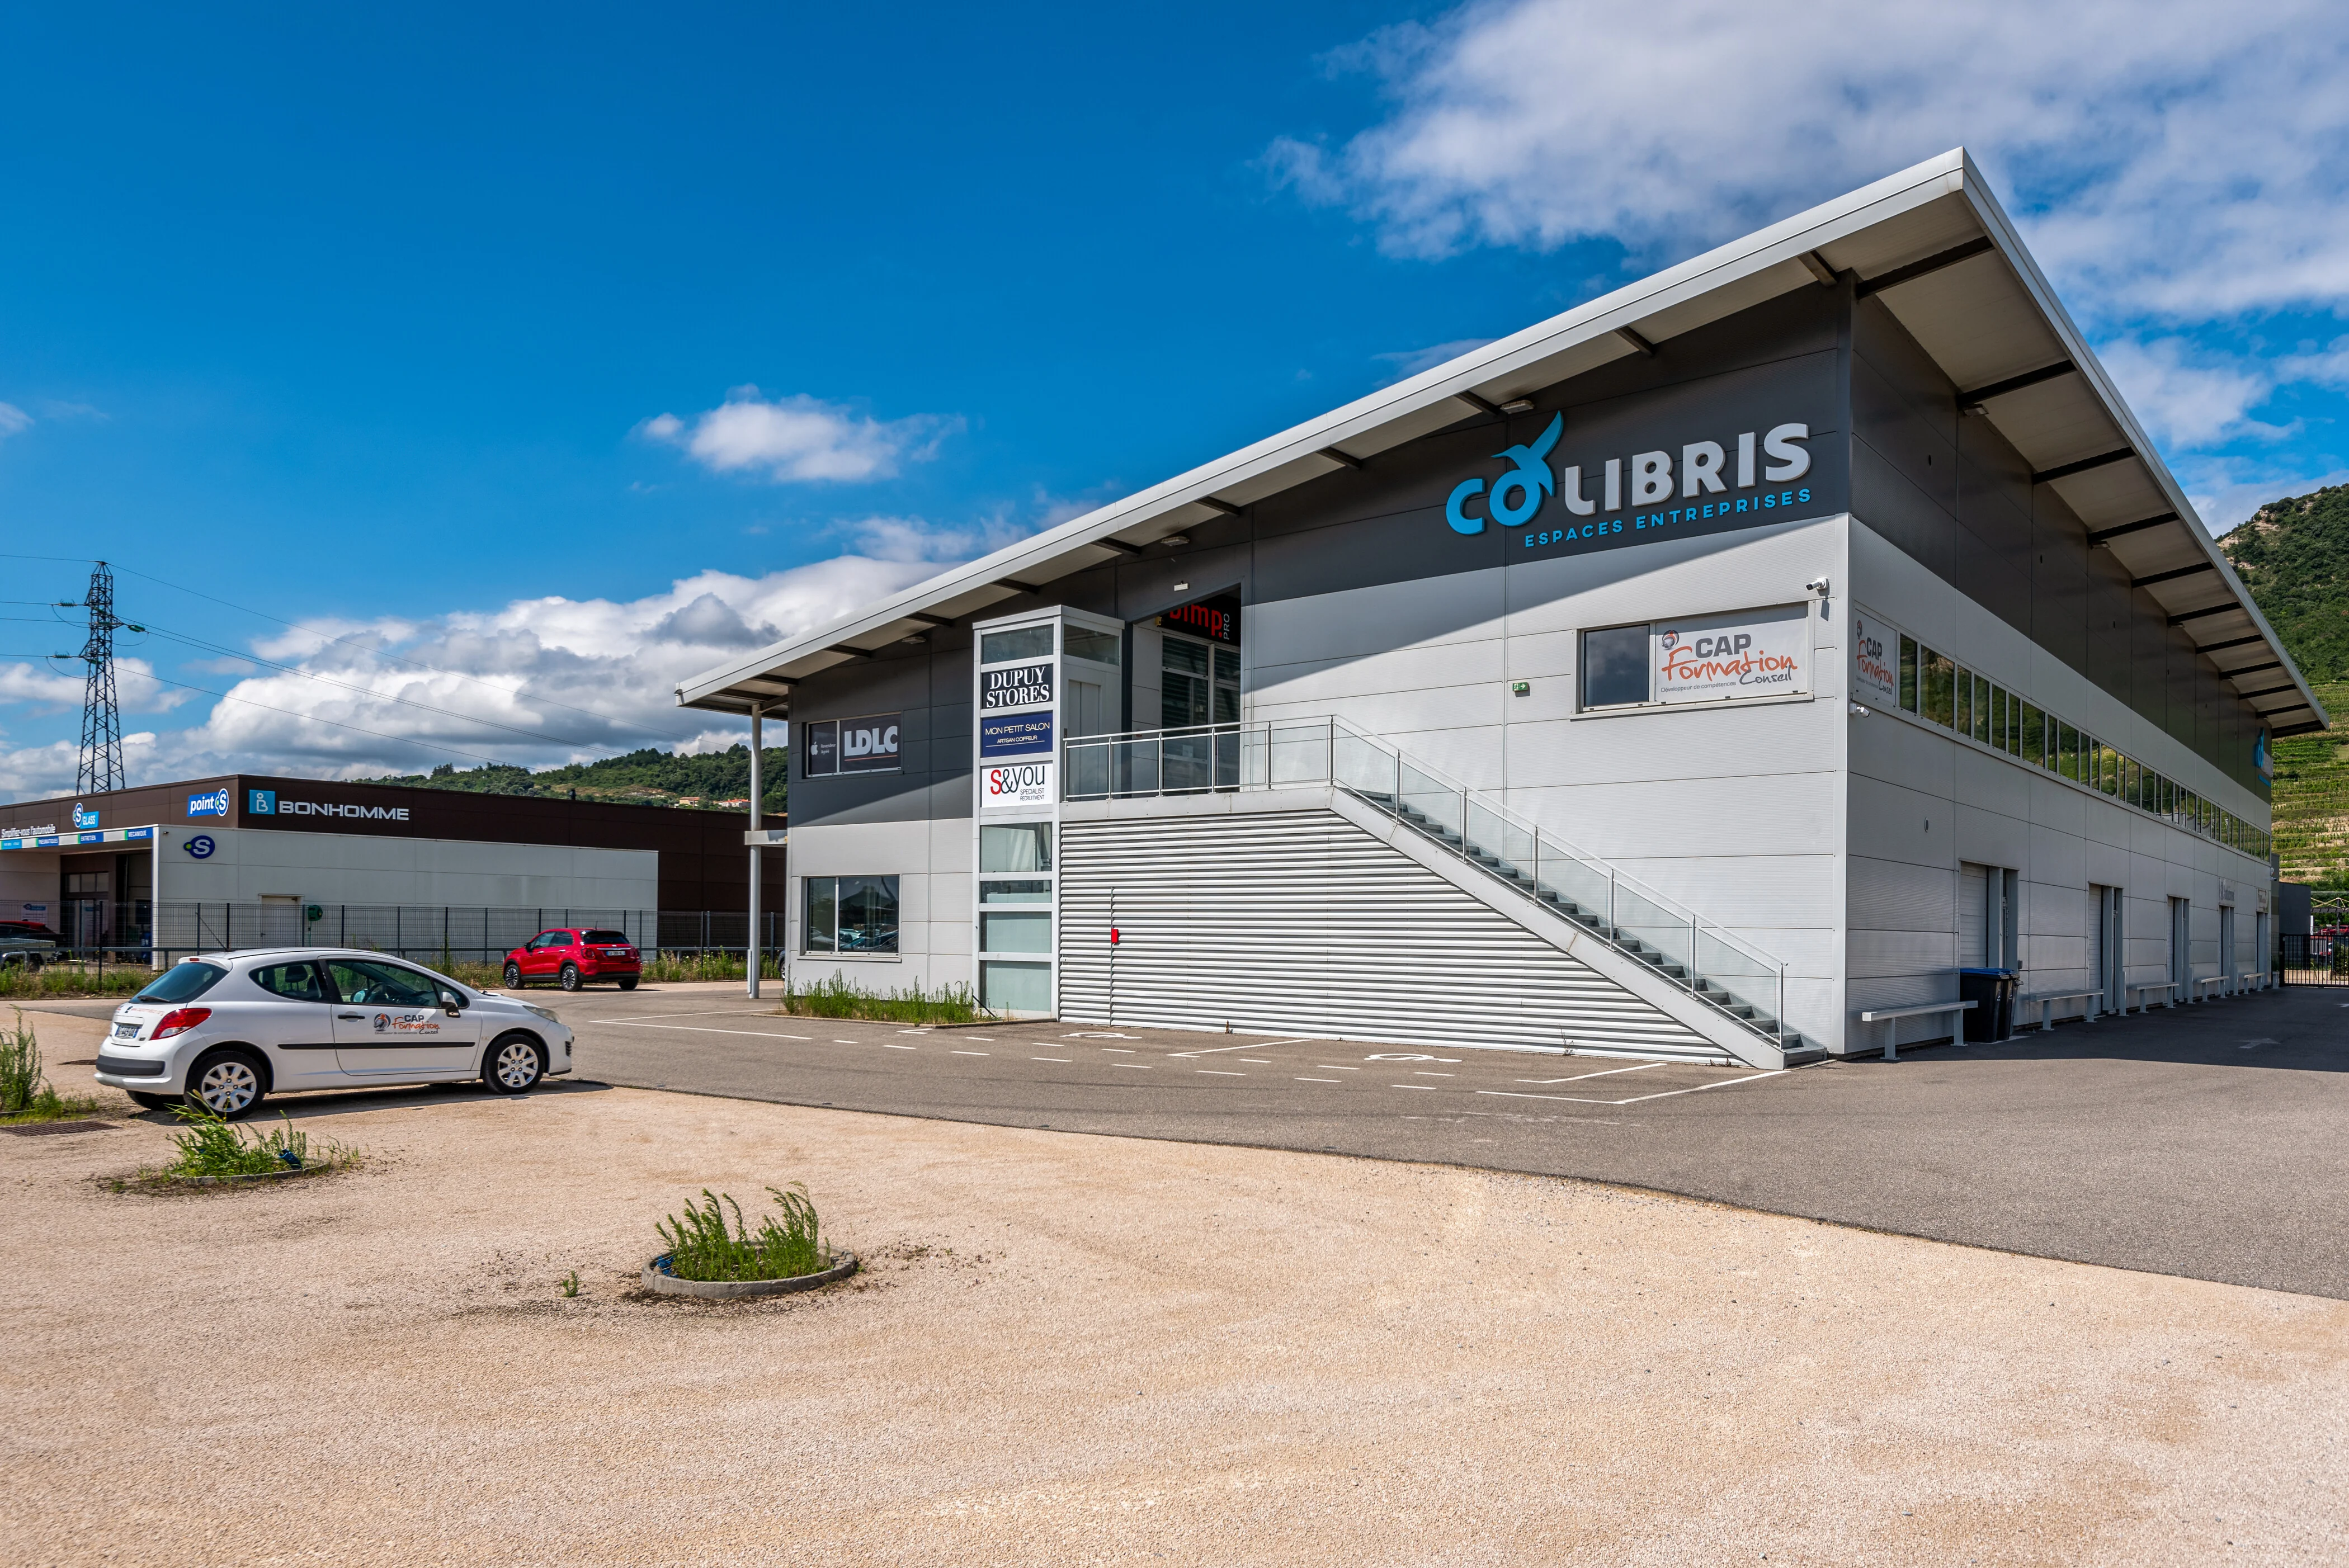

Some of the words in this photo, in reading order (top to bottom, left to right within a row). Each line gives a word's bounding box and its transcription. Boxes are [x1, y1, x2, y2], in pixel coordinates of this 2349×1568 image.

[1446, 410, 1811, 535] COLIBRIS
[1525, 520, 1624, 548] ESPACES
[1636, 488, 1812, 530] ENTREPRISES
[1695, 634, 1751, 659] CAP
[1866, 636, 1883, 660] CAP
[1661, 645, 1798, 682] Formation
[1856, 639, 1894, 687] Formation
[990, 666, 1046, 689] DUPUY
[1739, 665, 1792, 686] Conseil
[987, 684, 1050, 708] STORES
[985, 727, 1002, 735] MON
[1004, 725, 1023, 734] PETIT
[1025, 722, 1050, 731] SALON
[845, 726, 898, 757] LDLC
[190, 796, 214, 814] point
[279, 800, 409, 821] BONHOMME
[82, 815, 96, 825] GLASS
[392, 1016, 441, 1031] Formation
